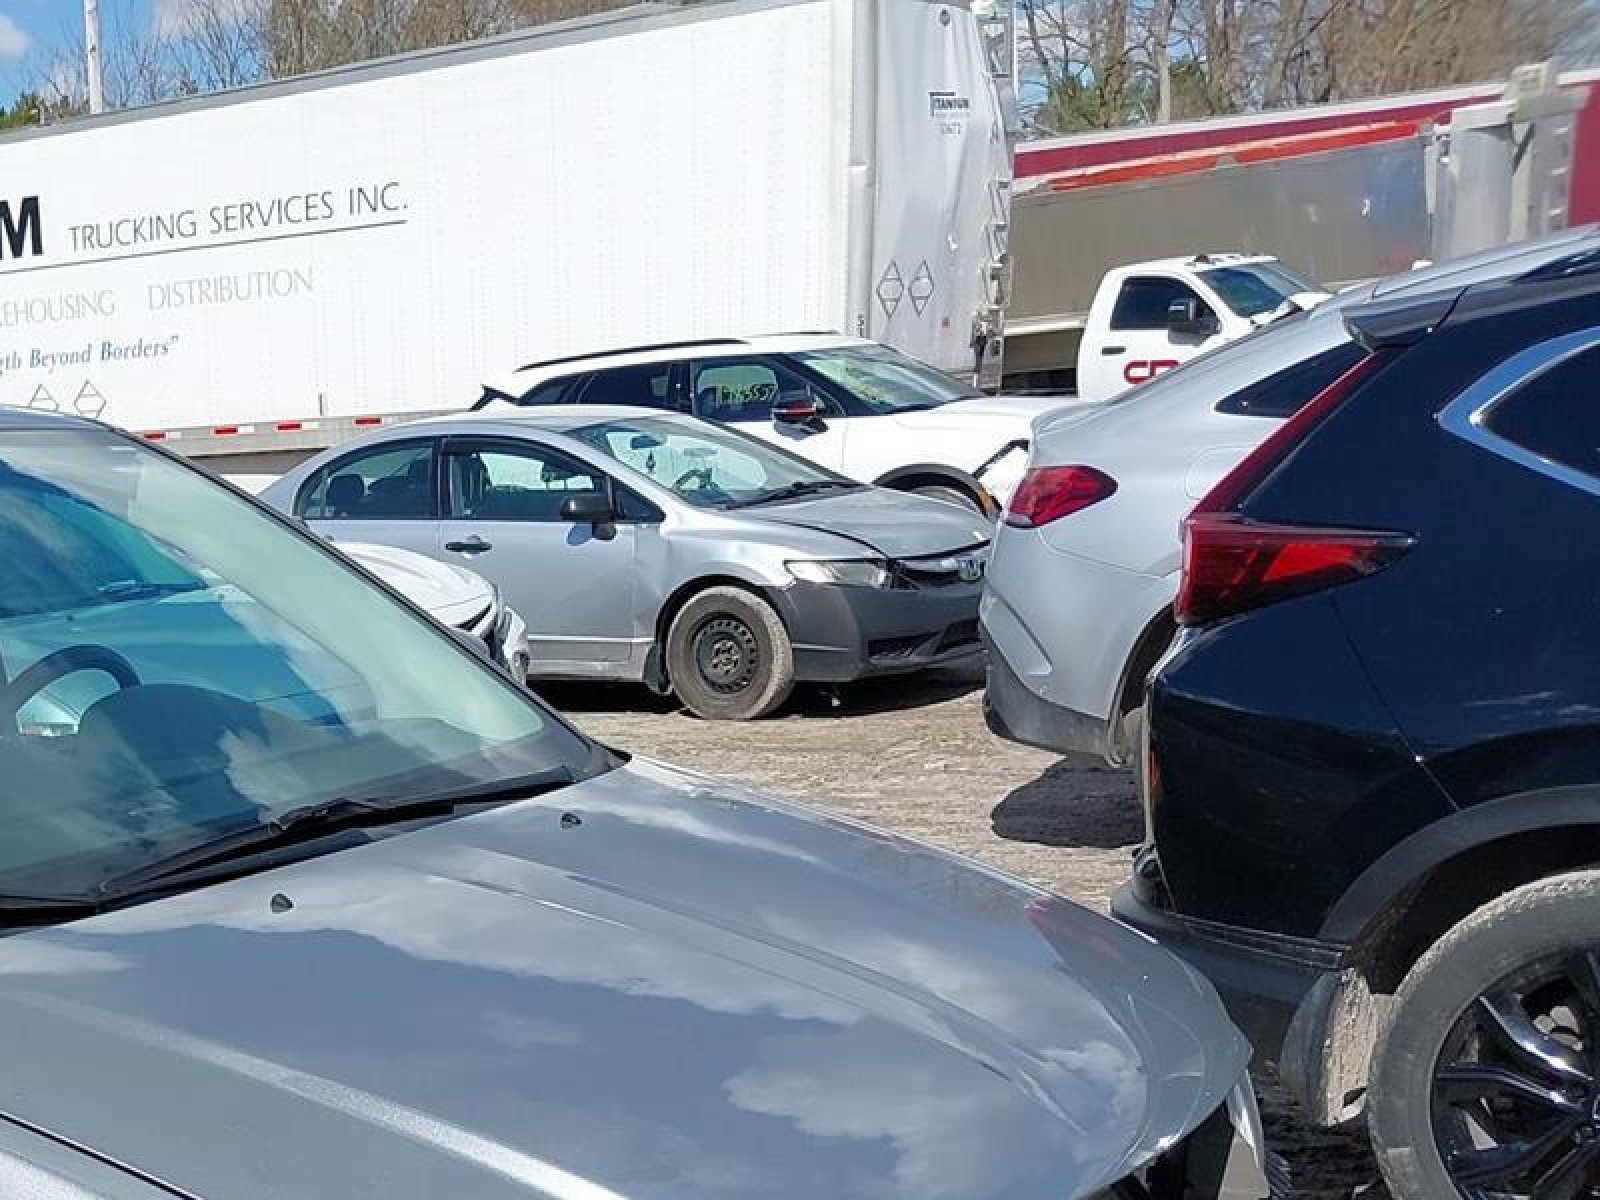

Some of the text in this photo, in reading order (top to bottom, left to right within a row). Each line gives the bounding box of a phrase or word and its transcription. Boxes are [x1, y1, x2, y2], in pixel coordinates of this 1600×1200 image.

[68, 209, 197, 252] TRUCKING
[209, 191, 334, 234] SERVICES
[349, 182, 408, 215] INC.
[147, 265, 314, 311] DISTRIBUTION
[29, 343, 92, 374] Beyond
